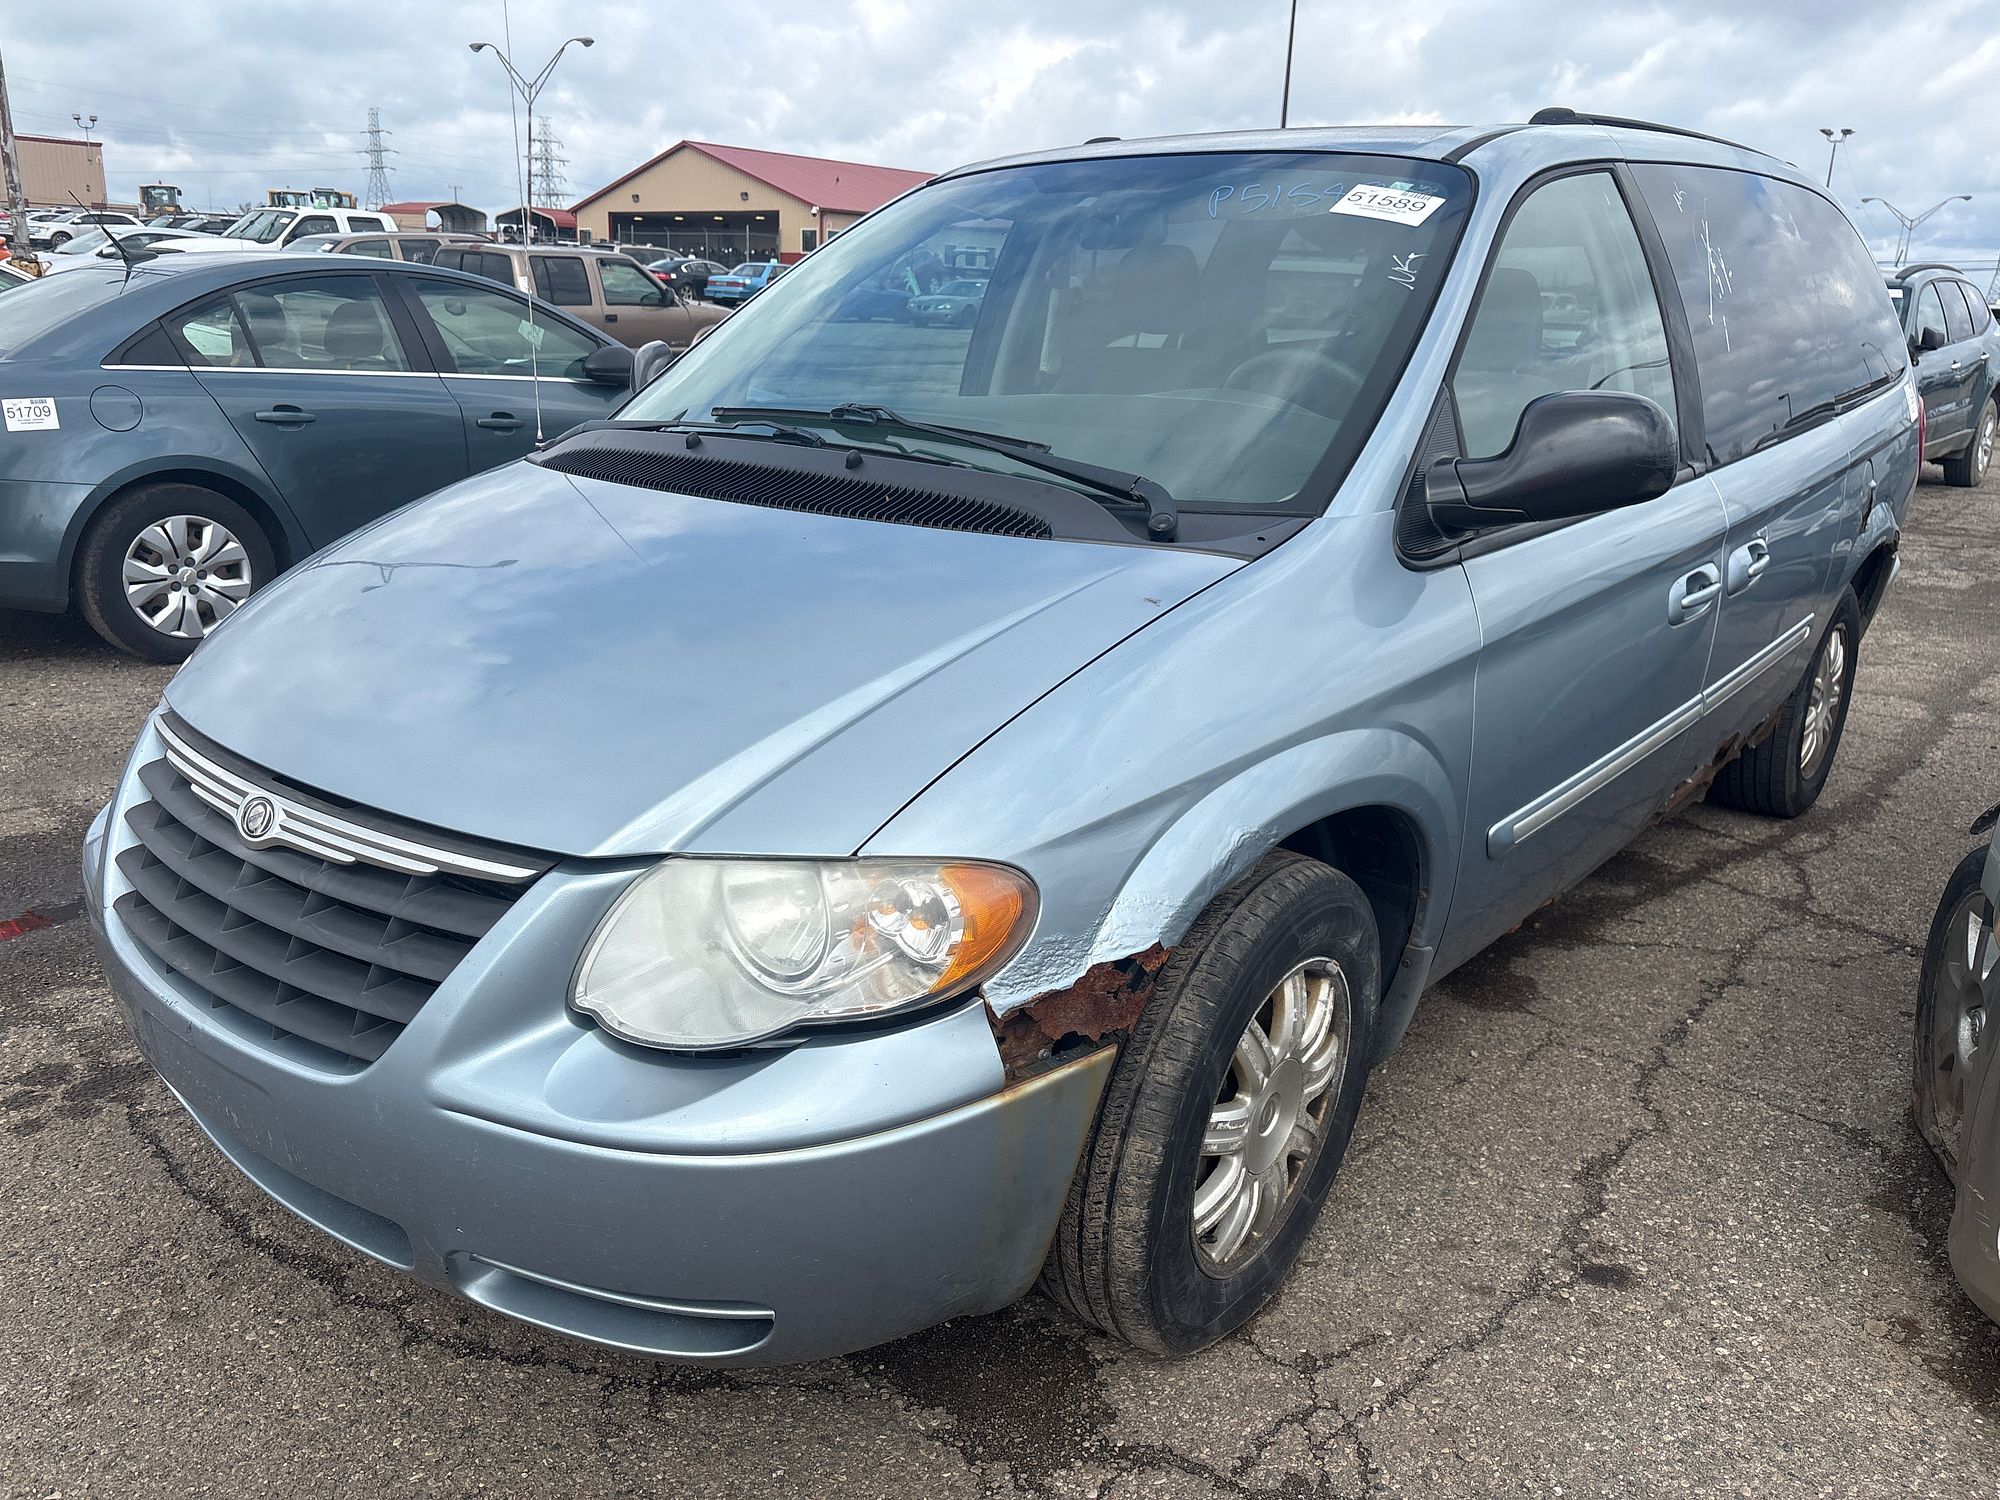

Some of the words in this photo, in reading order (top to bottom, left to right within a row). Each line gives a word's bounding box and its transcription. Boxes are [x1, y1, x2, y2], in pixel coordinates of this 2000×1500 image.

[1208, 181, 1386, 218] P5154
[1347, 191, 1427, 212] 51589
[6, 405, 51, 419] 51709
